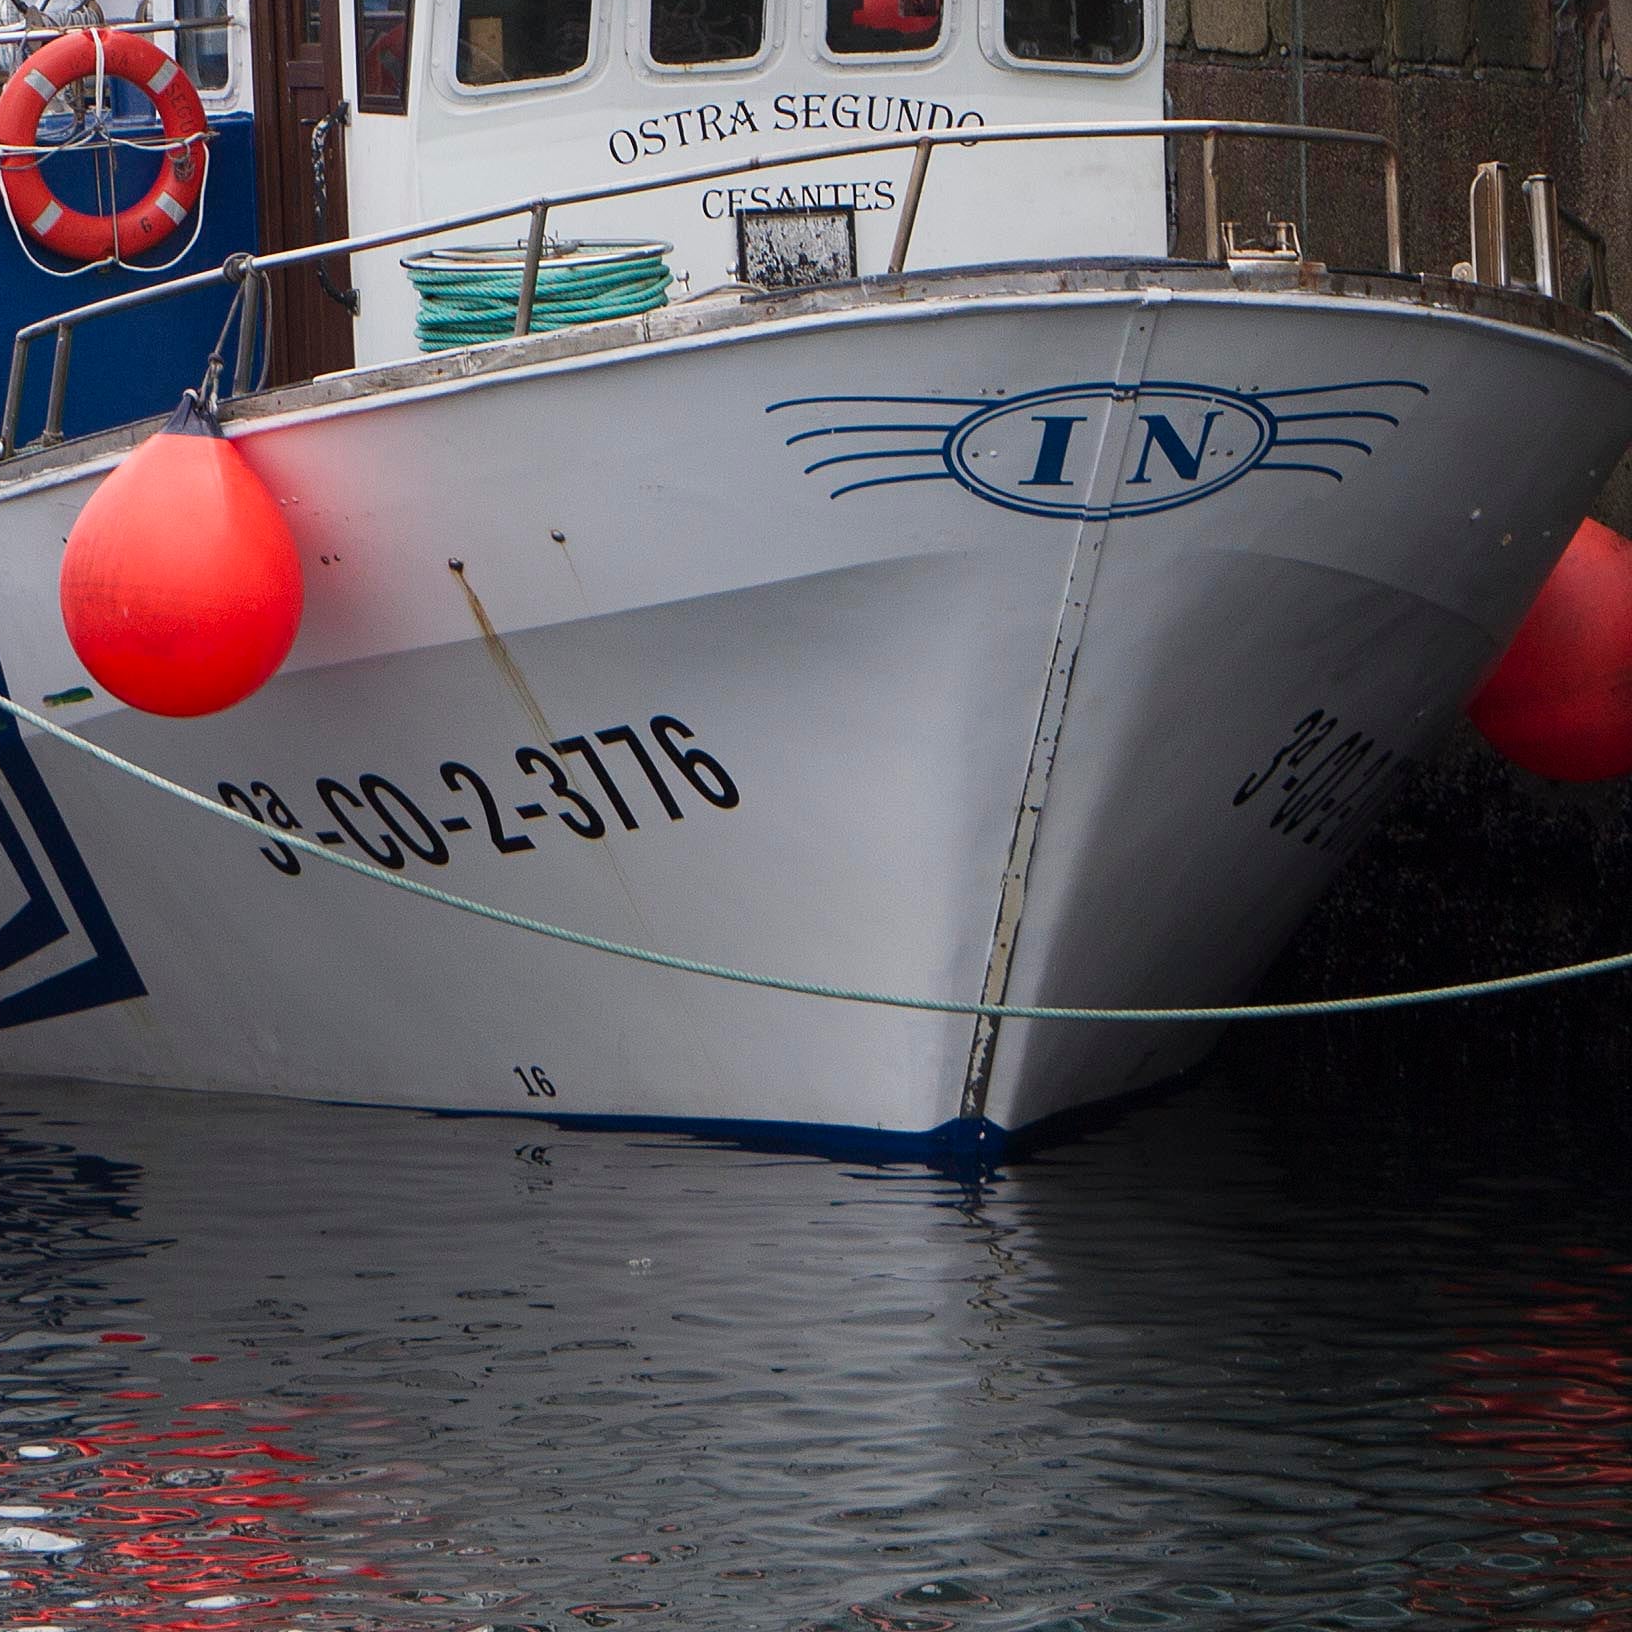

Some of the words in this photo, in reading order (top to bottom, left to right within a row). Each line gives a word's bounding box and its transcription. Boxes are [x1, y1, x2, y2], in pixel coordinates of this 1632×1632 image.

[608, 99, 759, 165] OSTRA
[773, 93, 985, 148] SEGUNDO
[702, 180, 896, 220] CESANTES
[513, 1066, 556, 1097] 16
